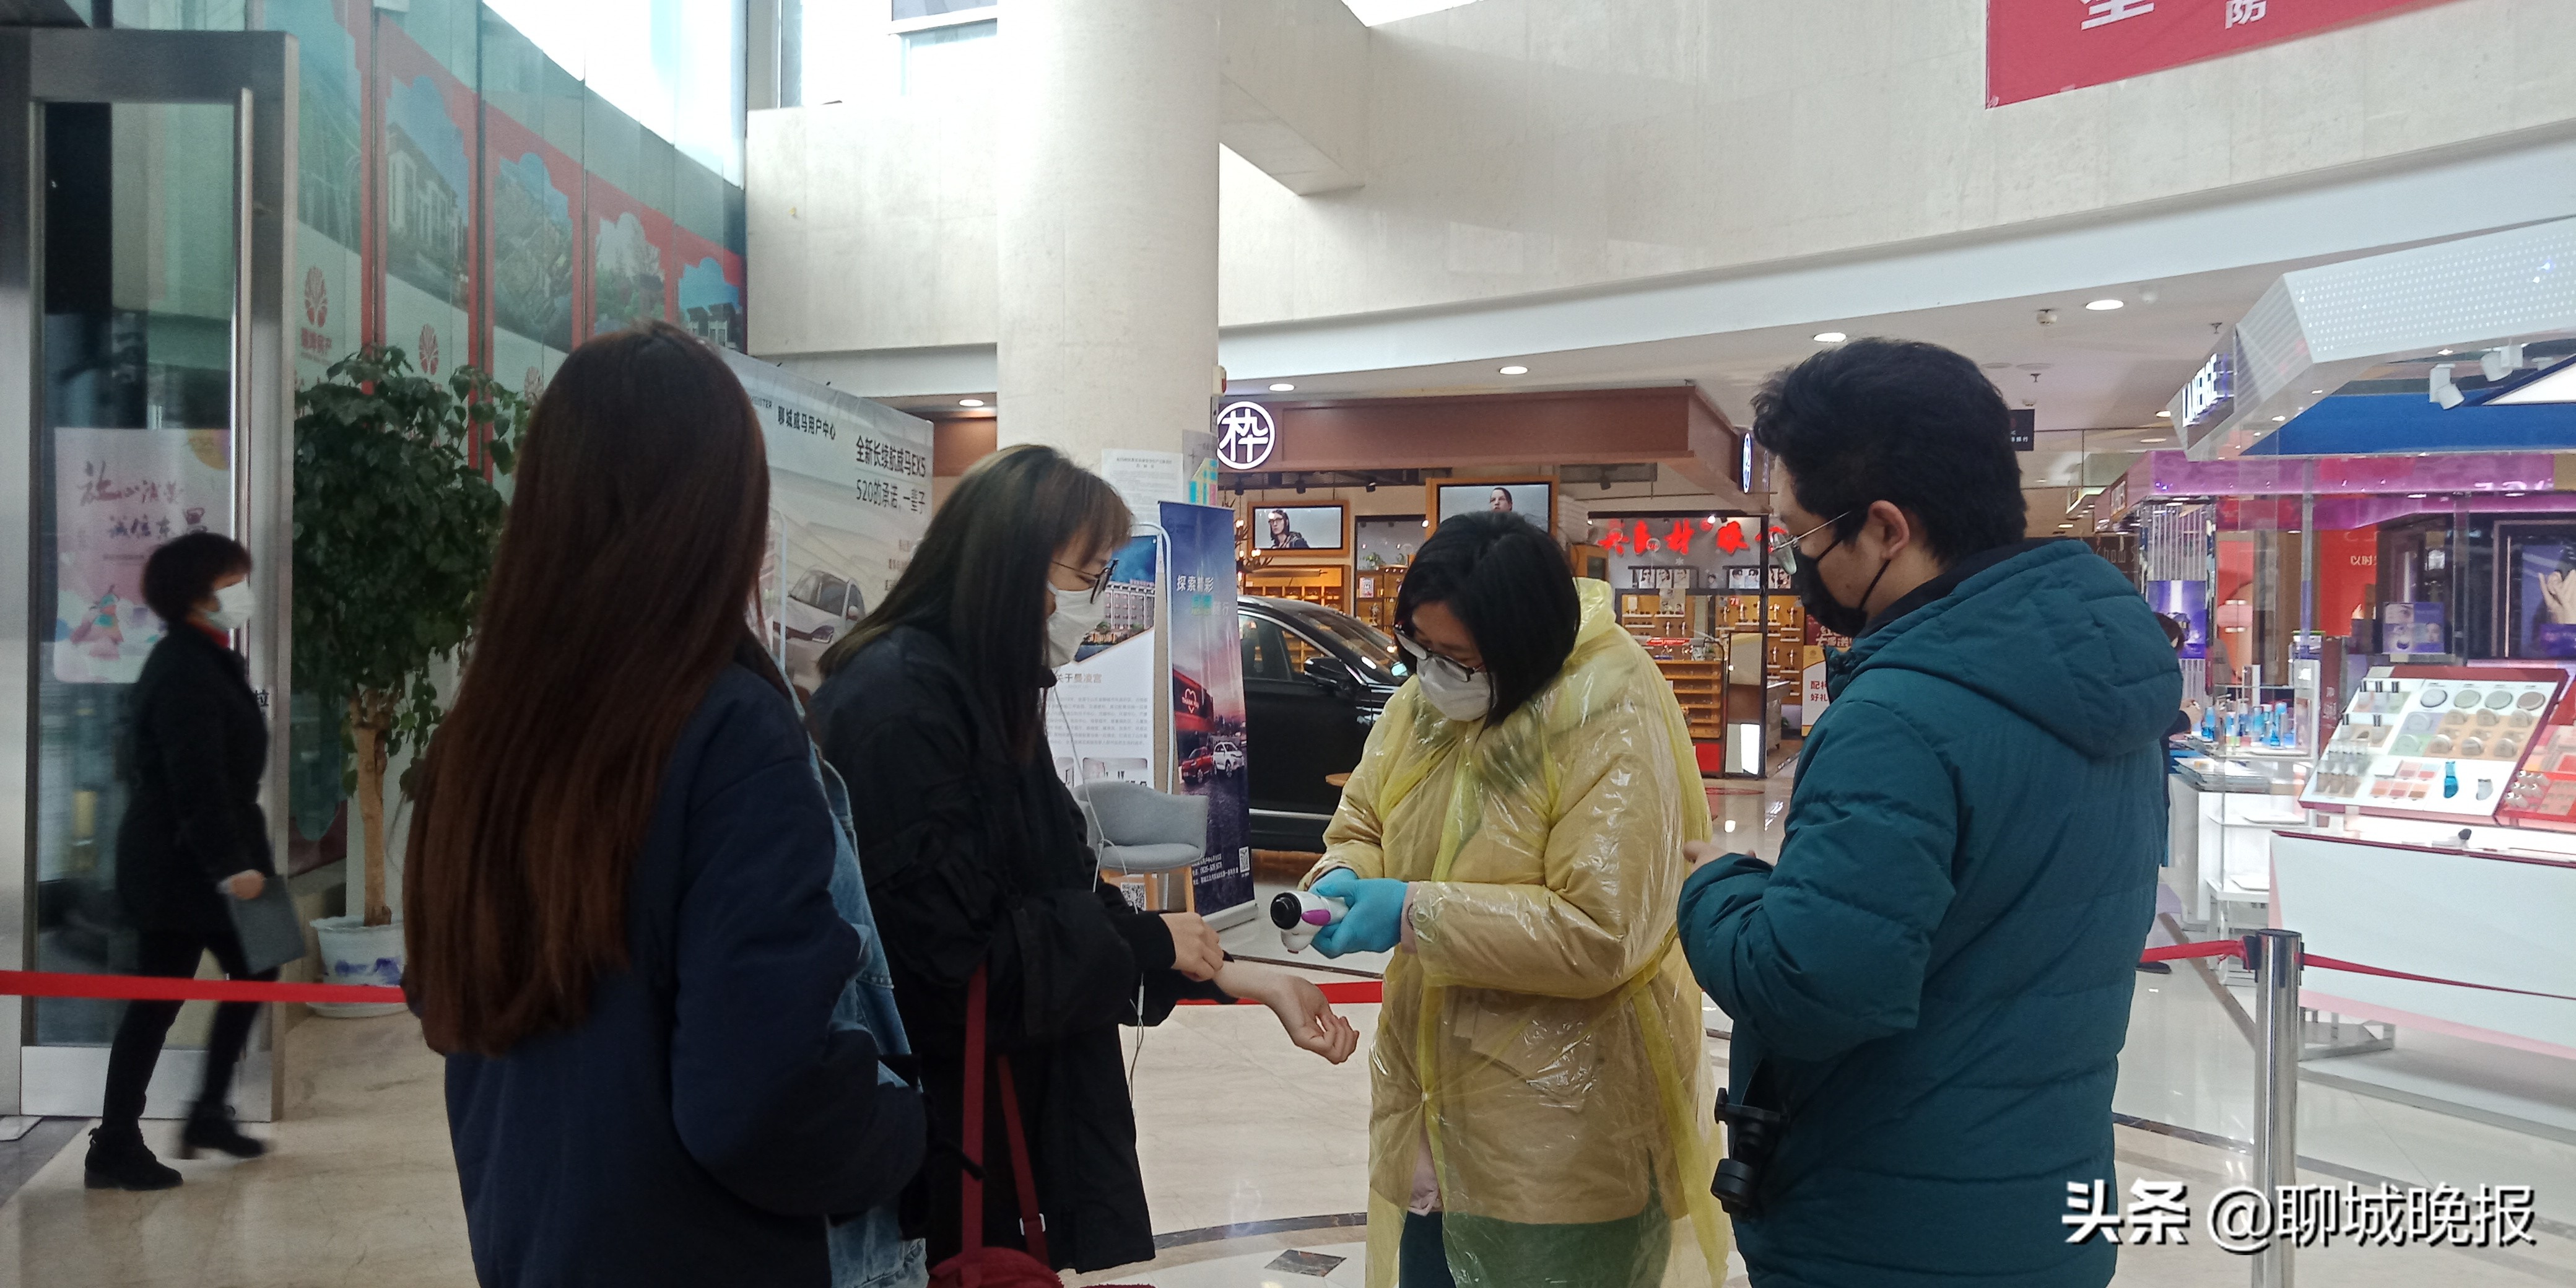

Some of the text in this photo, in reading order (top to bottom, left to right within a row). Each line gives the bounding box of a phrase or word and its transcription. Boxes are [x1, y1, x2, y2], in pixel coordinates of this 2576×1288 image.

[777, 405, 836, 440] 聊城威马用户中心
[856, 435, 926, 478] 全新长续航威马EX5
[1177, 574, 1214, 593] 探索精彩
